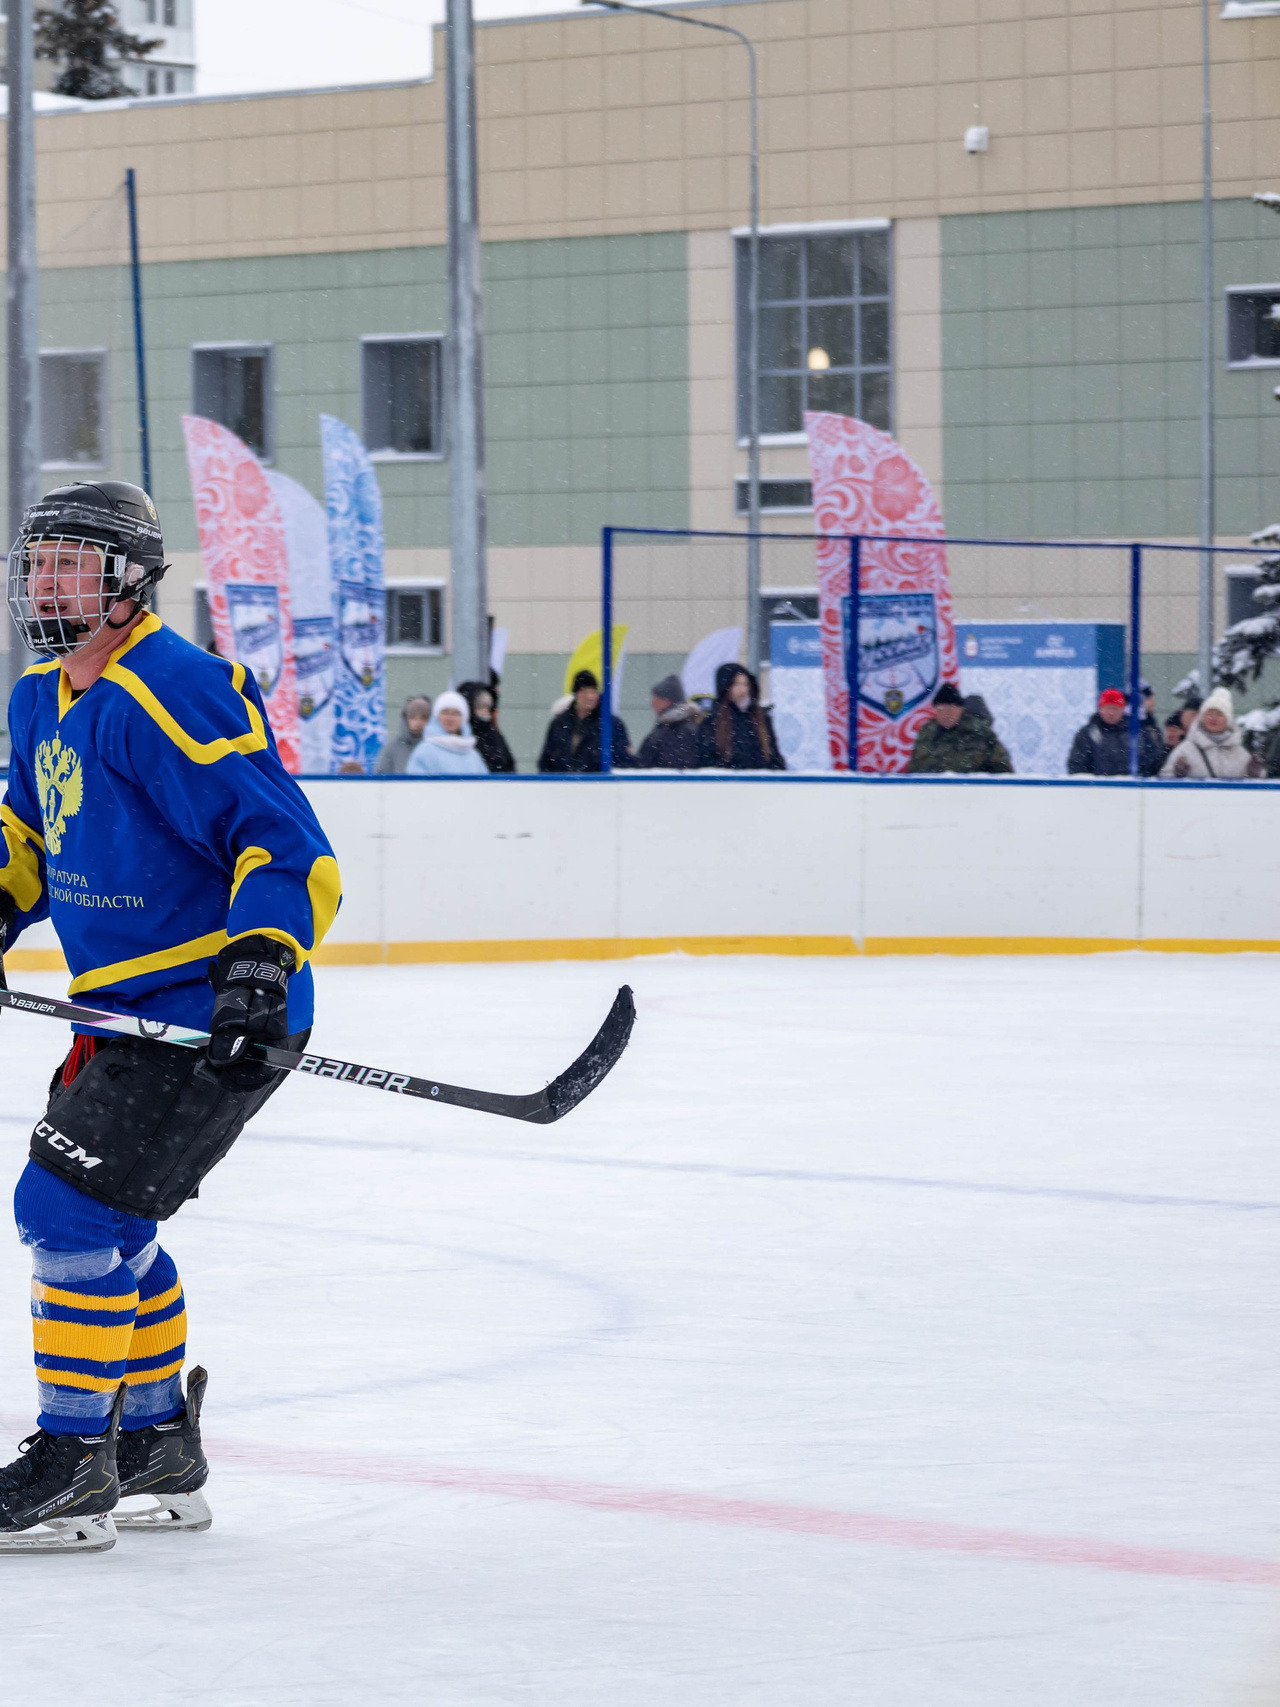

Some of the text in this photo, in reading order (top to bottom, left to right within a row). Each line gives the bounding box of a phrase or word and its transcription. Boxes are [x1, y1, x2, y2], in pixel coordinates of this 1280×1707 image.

[30, 510, 60, 518] BAUER
[74, 893, 145, 908] ОБЛАСТИ
[16, 1000, 56, 1013] BAUER
[296, 1055, 411, 1094] BAUER
[35, 1120, 103, 1169] CCM
[38, 1492, 74, 1518] BAUER
